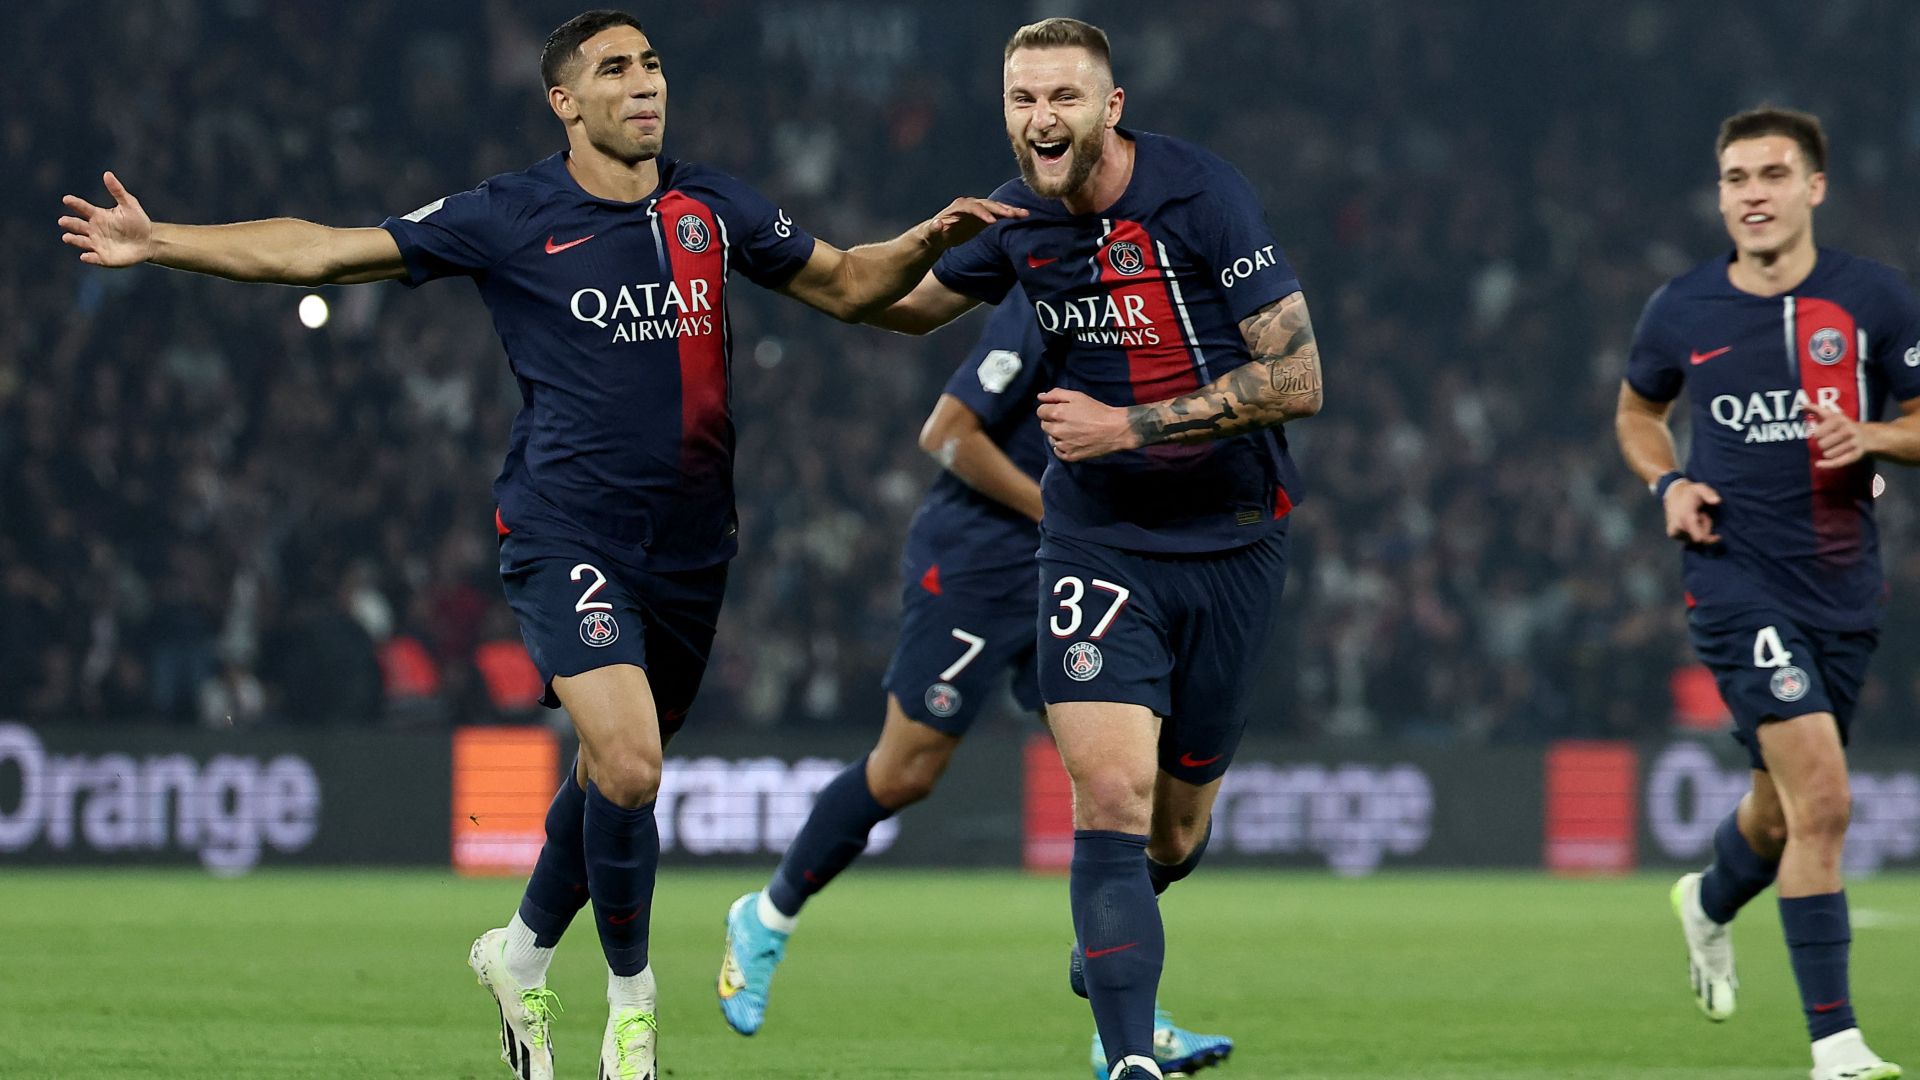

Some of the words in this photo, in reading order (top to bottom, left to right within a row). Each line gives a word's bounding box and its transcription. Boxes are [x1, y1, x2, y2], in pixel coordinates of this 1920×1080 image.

[1220, 245, 1279, 288] GOAT
[570, 278, 712, 328] QATAR
[1035, 294, 1154, 335] QATAR
[611, 314, 713, 344] AIRWAYS
[1710, 386, 1842, 431] QATAR
[1744, 420, 1818, 443] AIRWA
[569, 563, 613, 614] 2
[1049, 575, 1130, 640] 37
[583, 612, 610, 625] PARIS
[938, 627, 986, 682] 7
[1069, 643, 1096, 655] PARIS
[1753, 623, 1793, 668] 4
[0, 723, 320, 877] Orange
[1205, 761, 1435, 877] range
